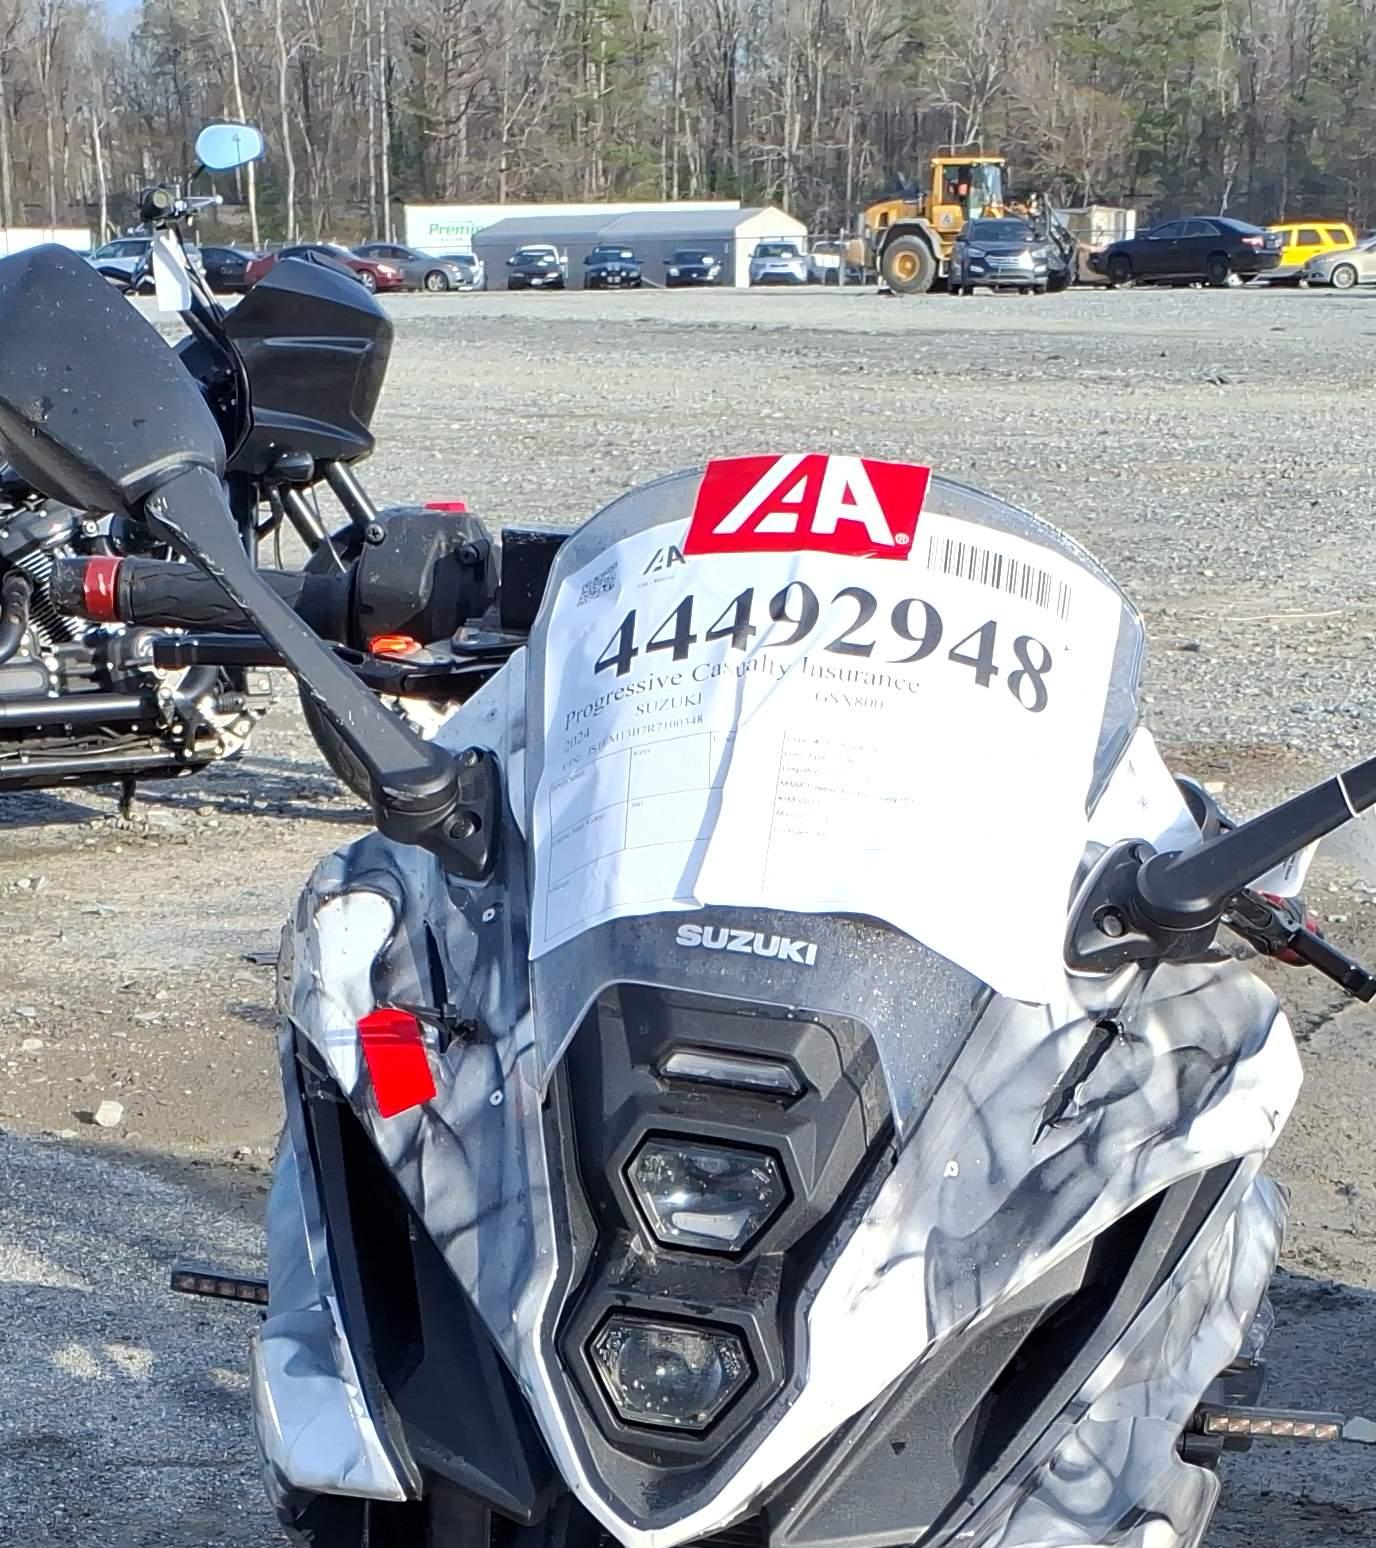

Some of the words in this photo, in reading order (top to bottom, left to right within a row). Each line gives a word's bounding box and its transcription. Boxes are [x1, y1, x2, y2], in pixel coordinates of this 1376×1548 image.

[593, 580, 1054, 714] 44492948
[563, 728, 590, 753] 2024
[635, 692, 702, 716] SUZUKI
[565, 673, 683, 731] Progressive
[691, 656, 791, 682] Casualty
[801, 657, 921, 693] Insurance
[676, 924, 818, 967] SUZUKI
